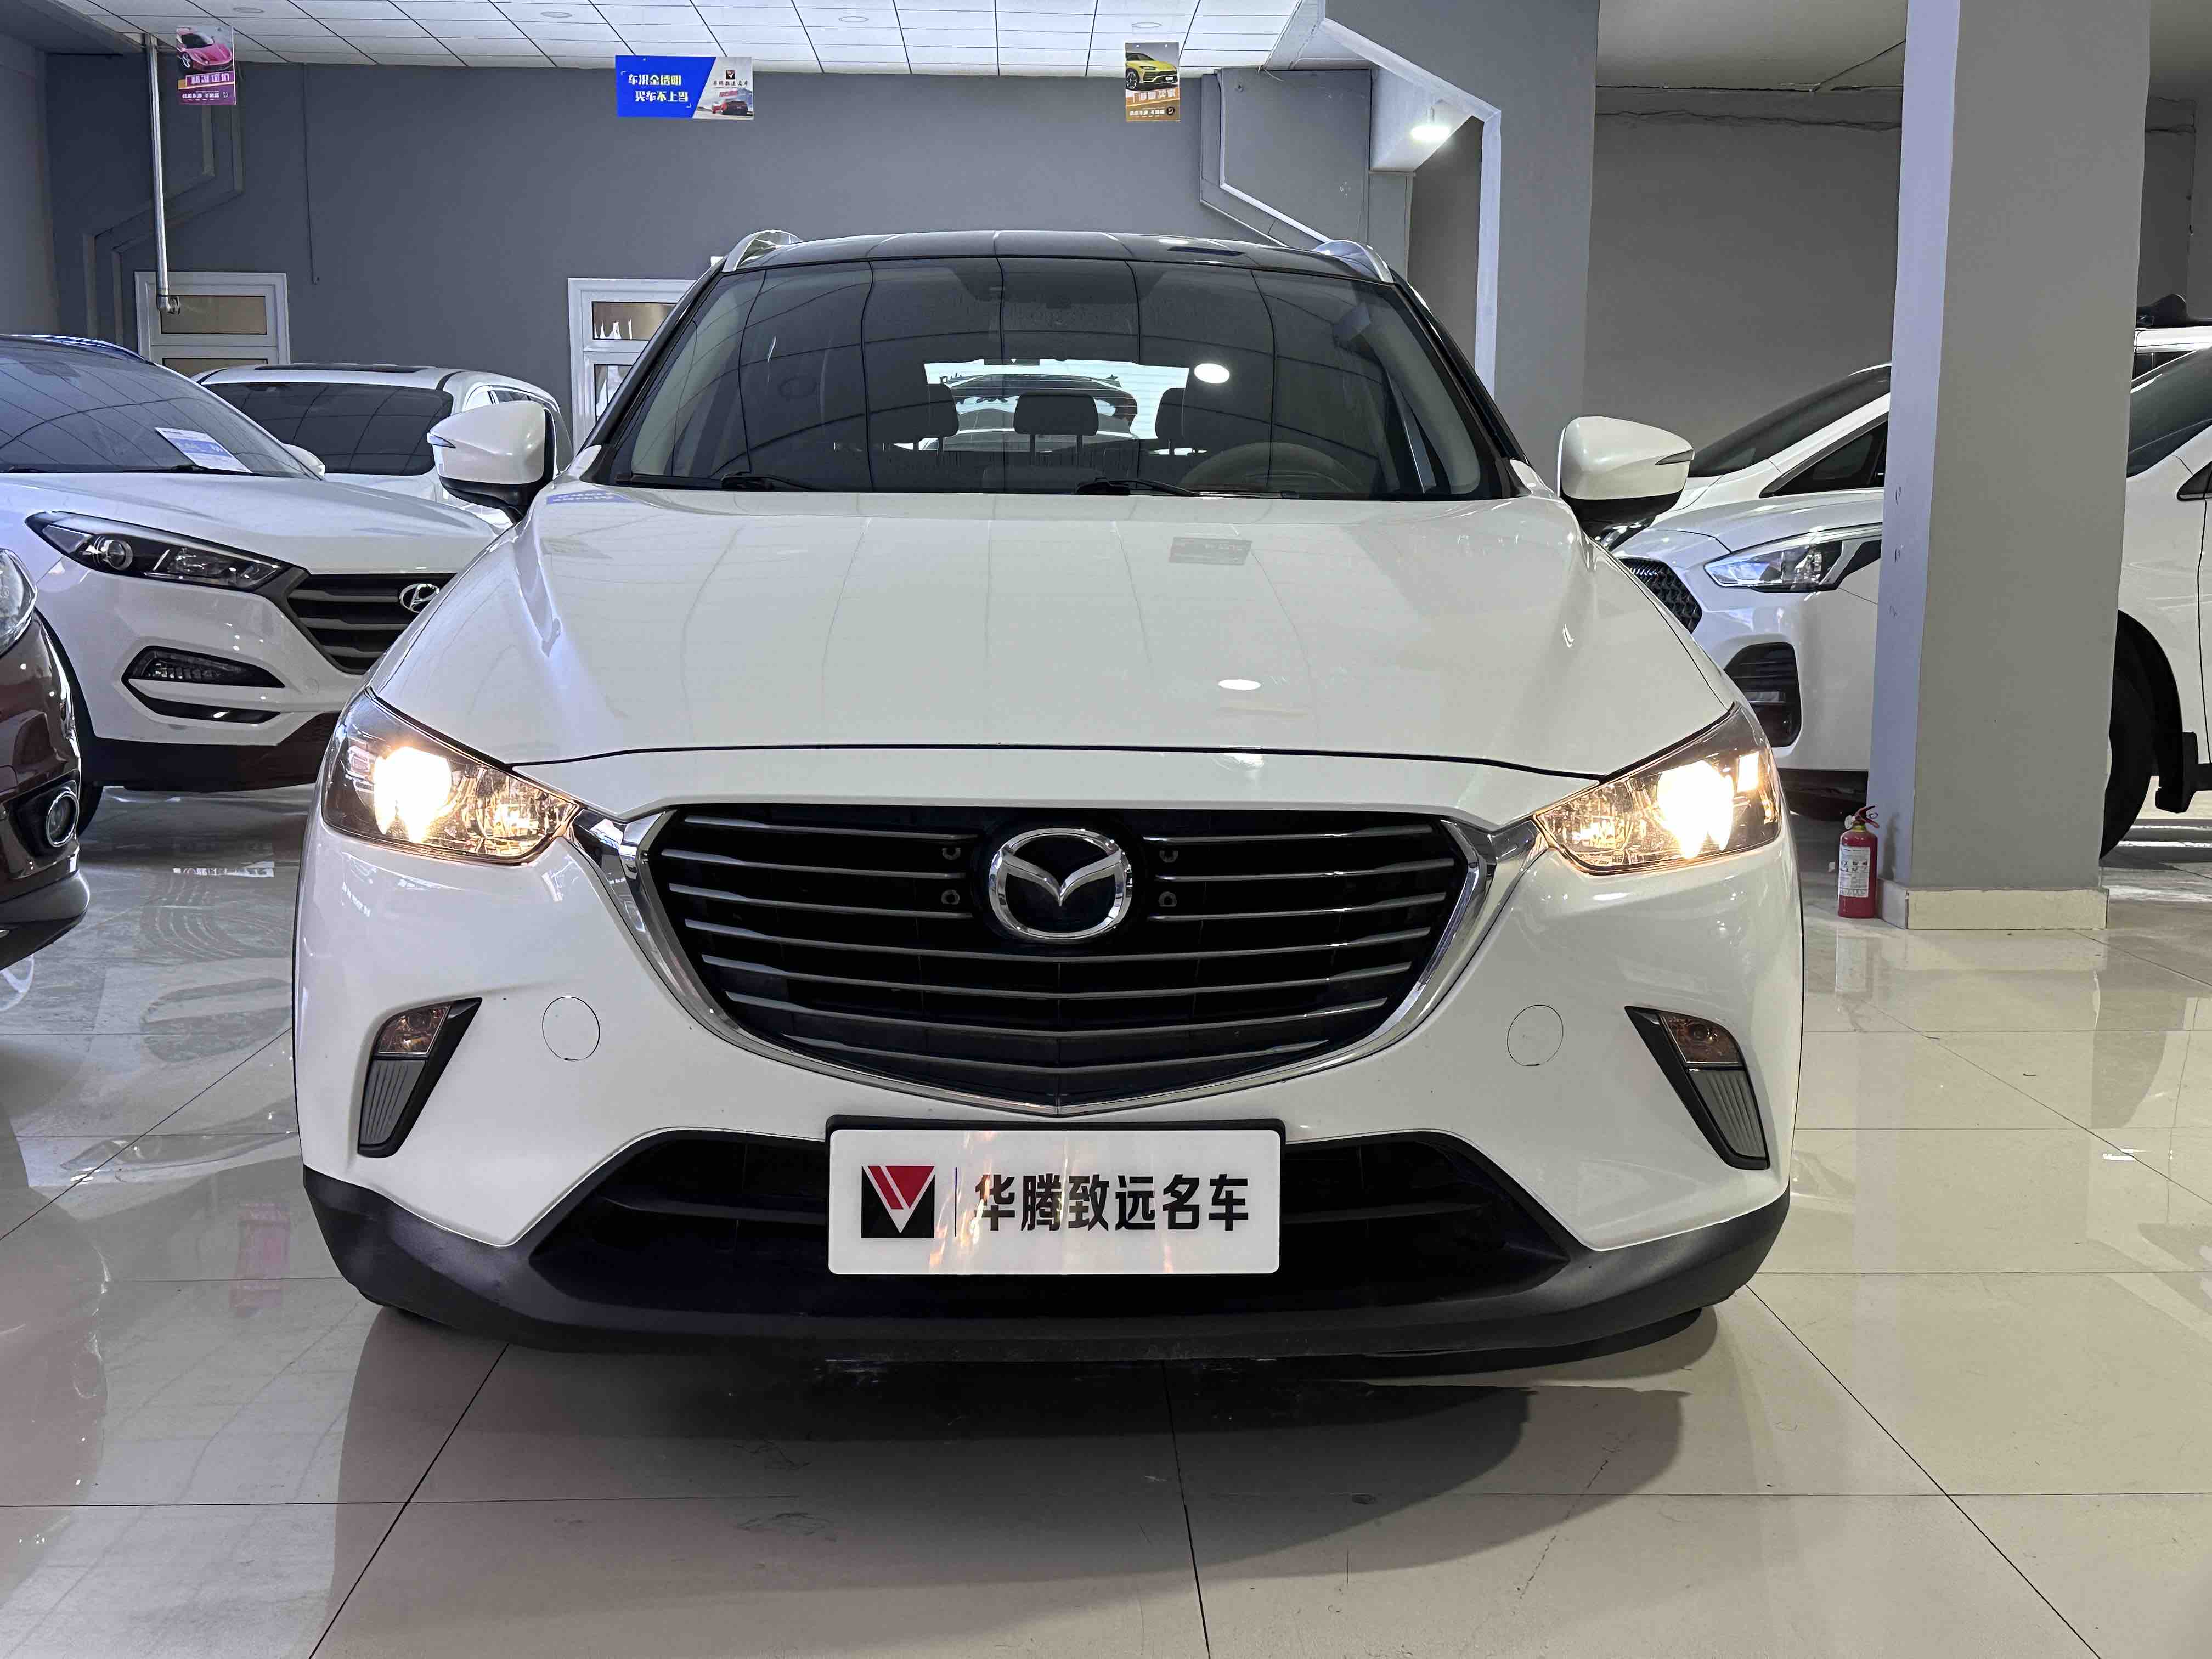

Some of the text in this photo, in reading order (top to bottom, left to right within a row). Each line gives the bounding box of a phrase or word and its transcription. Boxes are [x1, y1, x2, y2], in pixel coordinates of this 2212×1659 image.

[635, 90, 689, 102] 买车不上当
[975, 1173, 1249, 1232] 华腾致远名车
